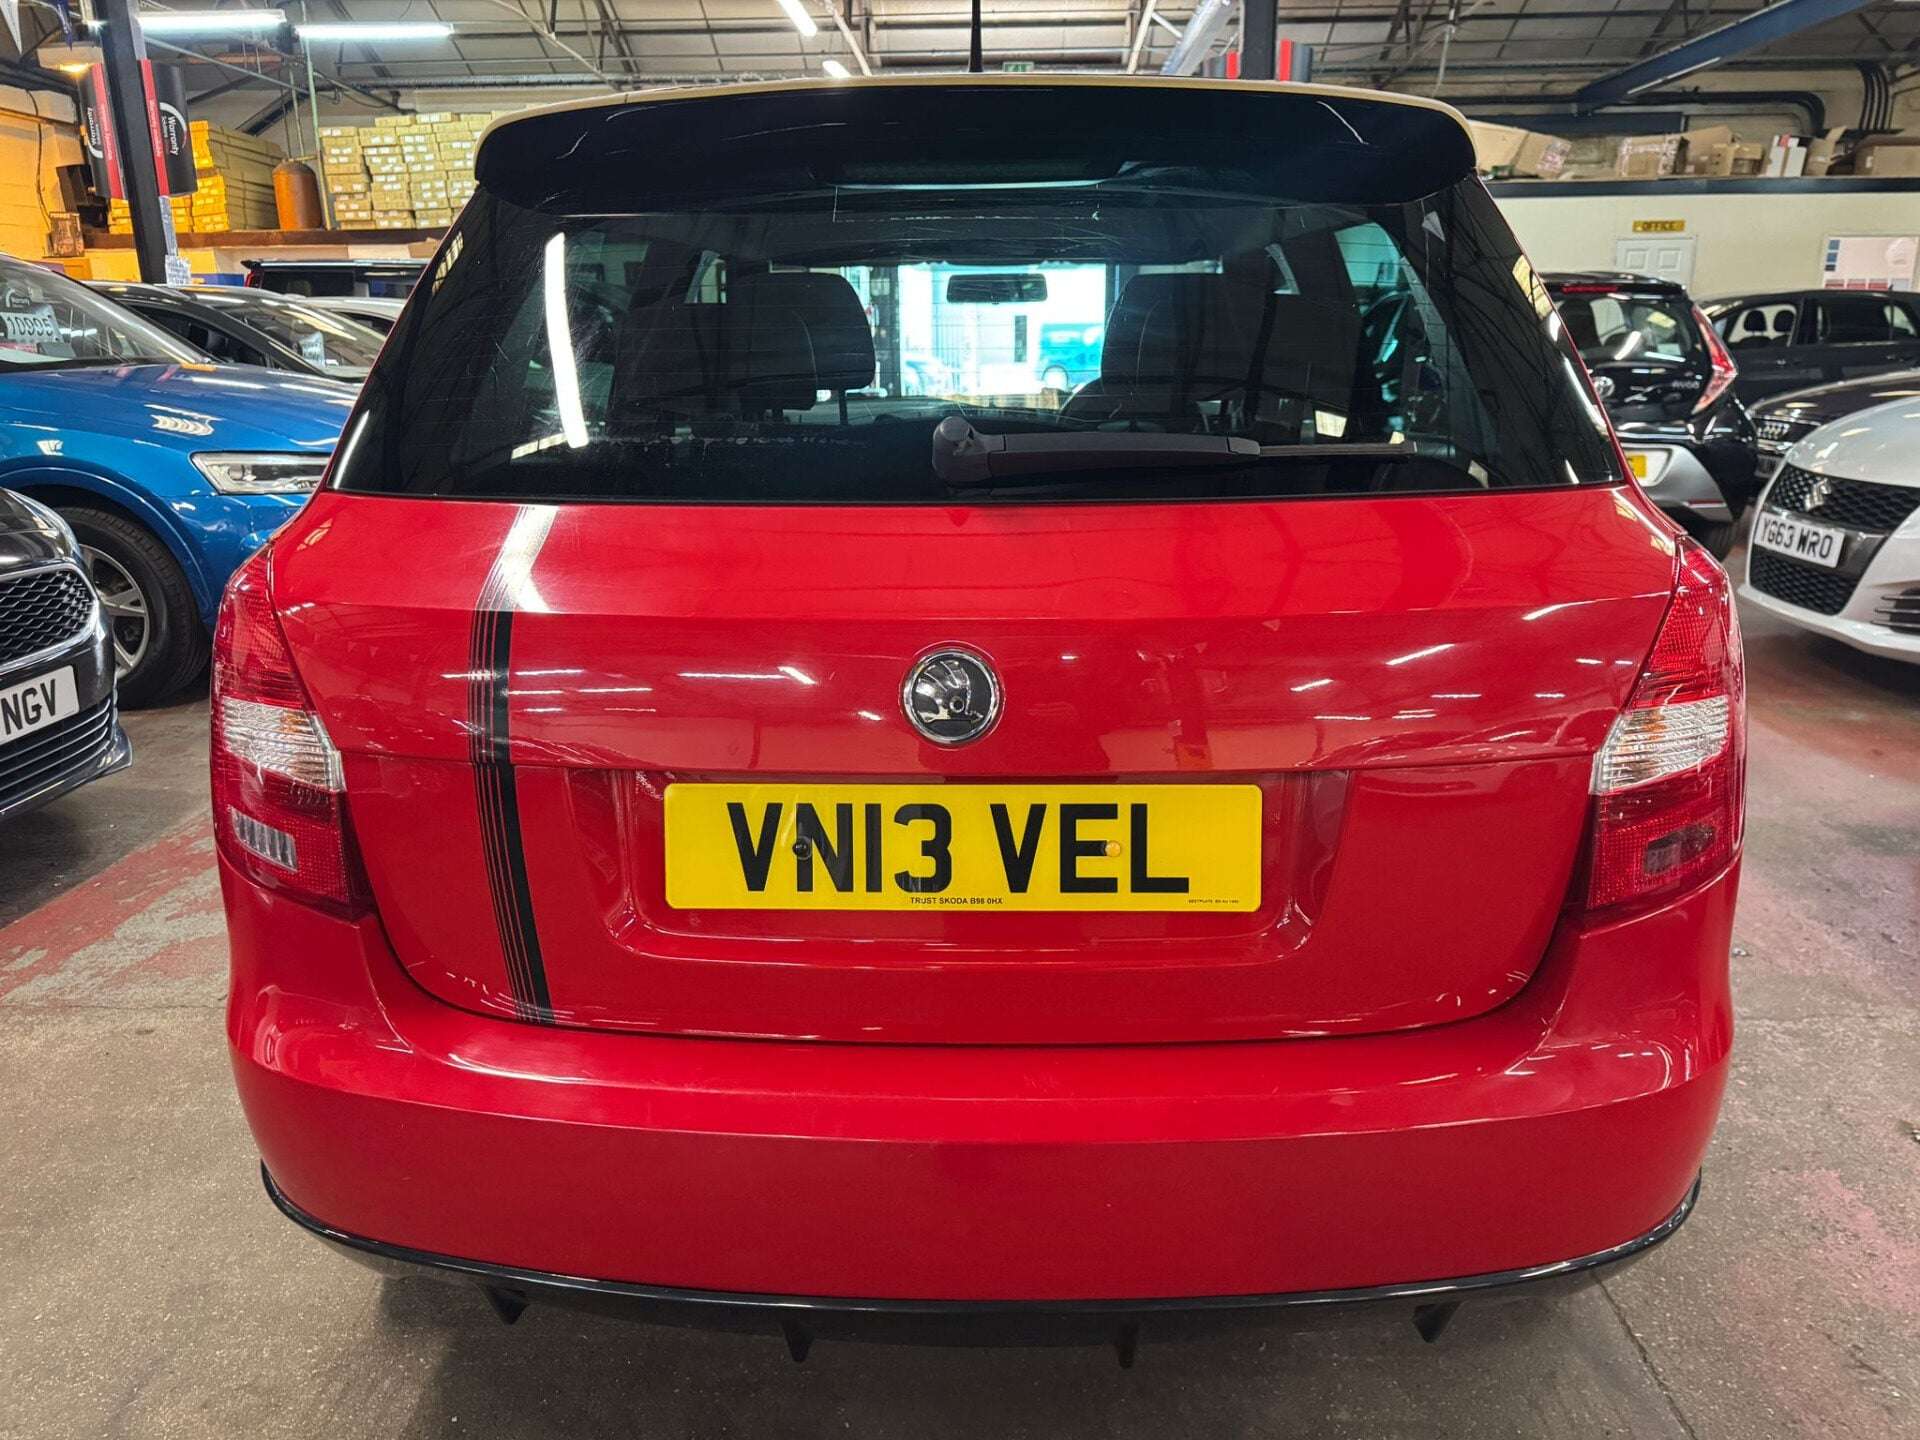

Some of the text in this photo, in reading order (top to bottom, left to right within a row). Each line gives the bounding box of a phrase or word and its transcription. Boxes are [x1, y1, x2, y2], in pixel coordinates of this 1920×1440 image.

[168, 116, 180, 156] Warranty
[1762, 518, 1834, 559] YG63 WRO
[0, 678, 56, 736] NGV
[727, 802, 1190, 893] VN13 VEL
[911, 897, 937, 905] TRUST
[940, 897, 968, 905] SKODA
